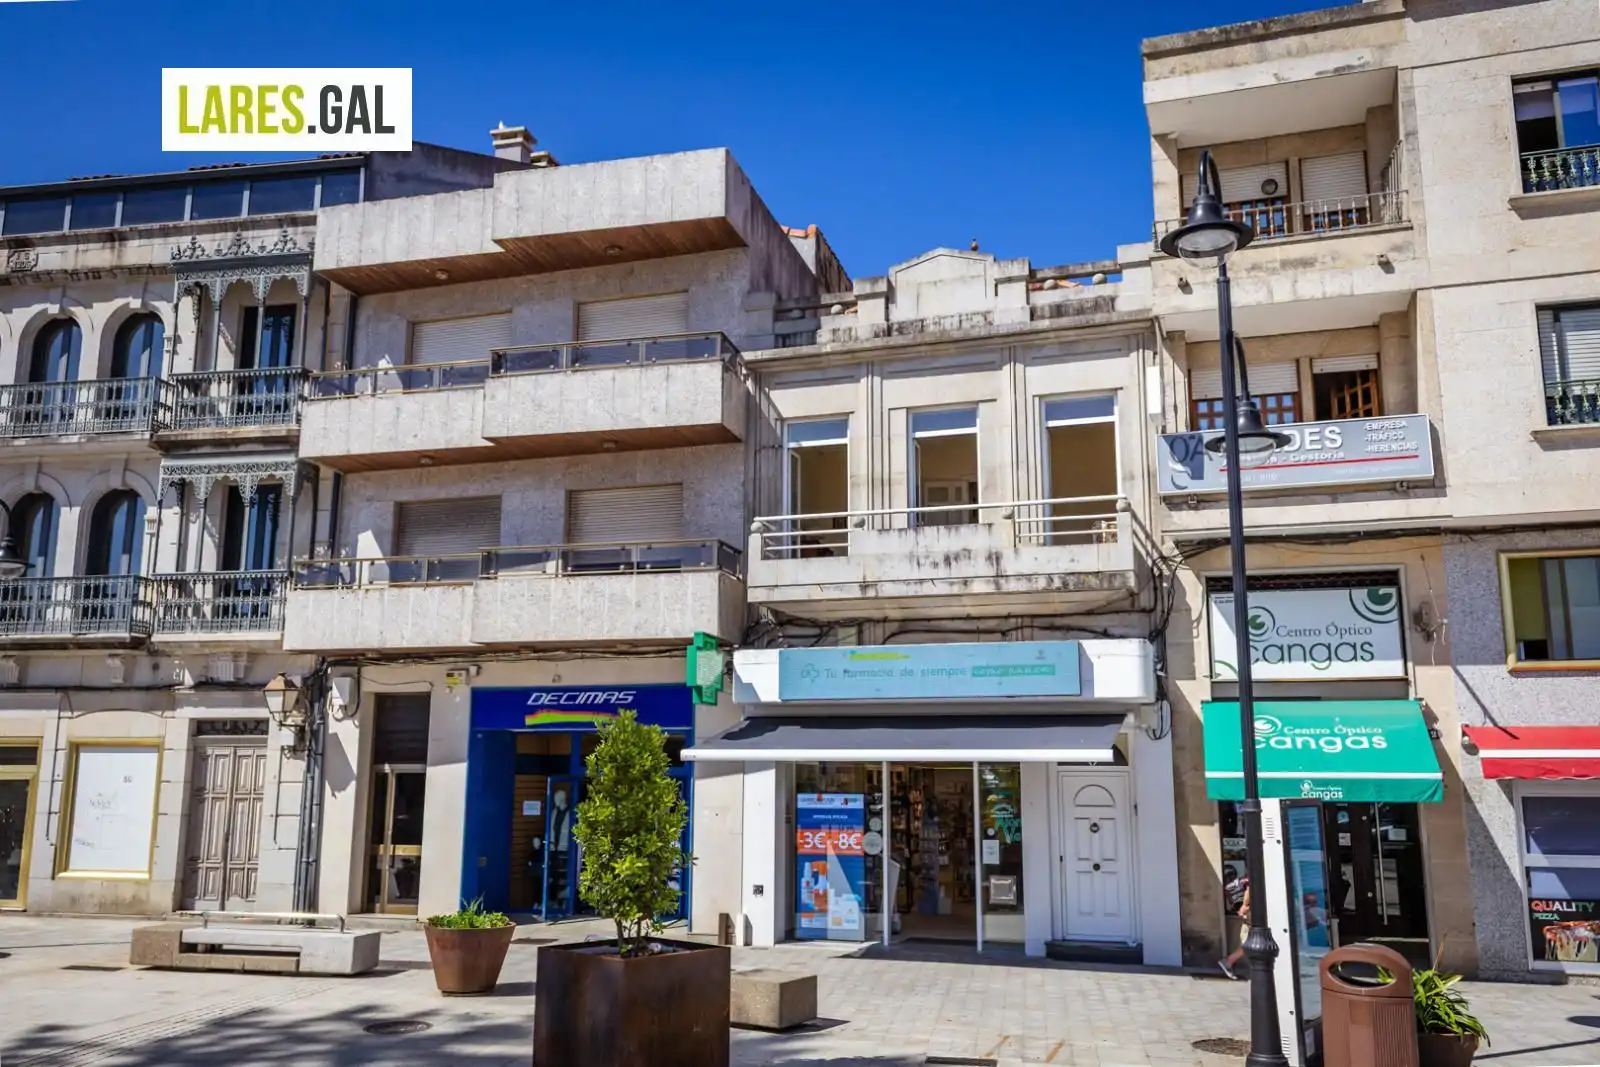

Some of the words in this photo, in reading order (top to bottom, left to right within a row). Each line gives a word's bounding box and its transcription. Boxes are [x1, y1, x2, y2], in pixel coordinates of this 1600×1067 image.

[1276, 625, 1321, 638] Centro
[1325, 622, 1373, 640] Óptico
[824, 668, 837, 679] Tu
[843, 666, 895, 679] farmacia
[901, 665, 915, 677] de
[920, 665, 968, 679] siempre
[527, 691, 637, 706] DECIMAS
[1283, 726, 1331, 735] Centro
[1302, 791, 1343, 801] cangas
[1531, 900, 1595, 912] QUALITY
[1533, 912, 1560, 920] PIZZA
